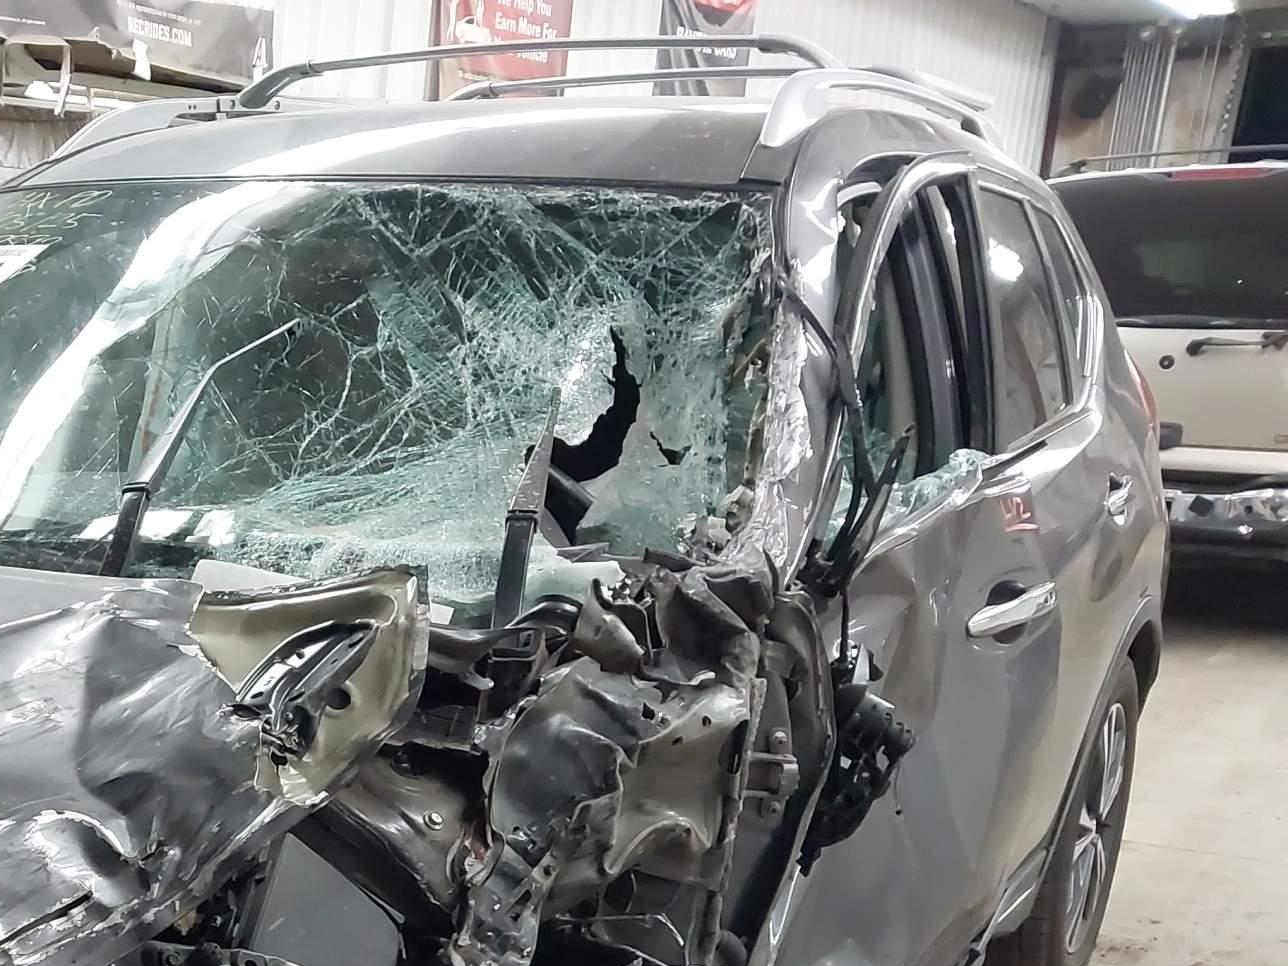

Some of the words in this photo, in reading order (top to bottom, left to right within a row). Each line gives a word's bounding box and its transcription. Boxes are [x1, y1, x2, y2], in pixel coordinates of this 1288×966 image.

[535, 0, 552, 17] You
[495, 11, 517, 33] Earn
[518, 16, 541, 38] More
[542, 22, 558, 41] For
